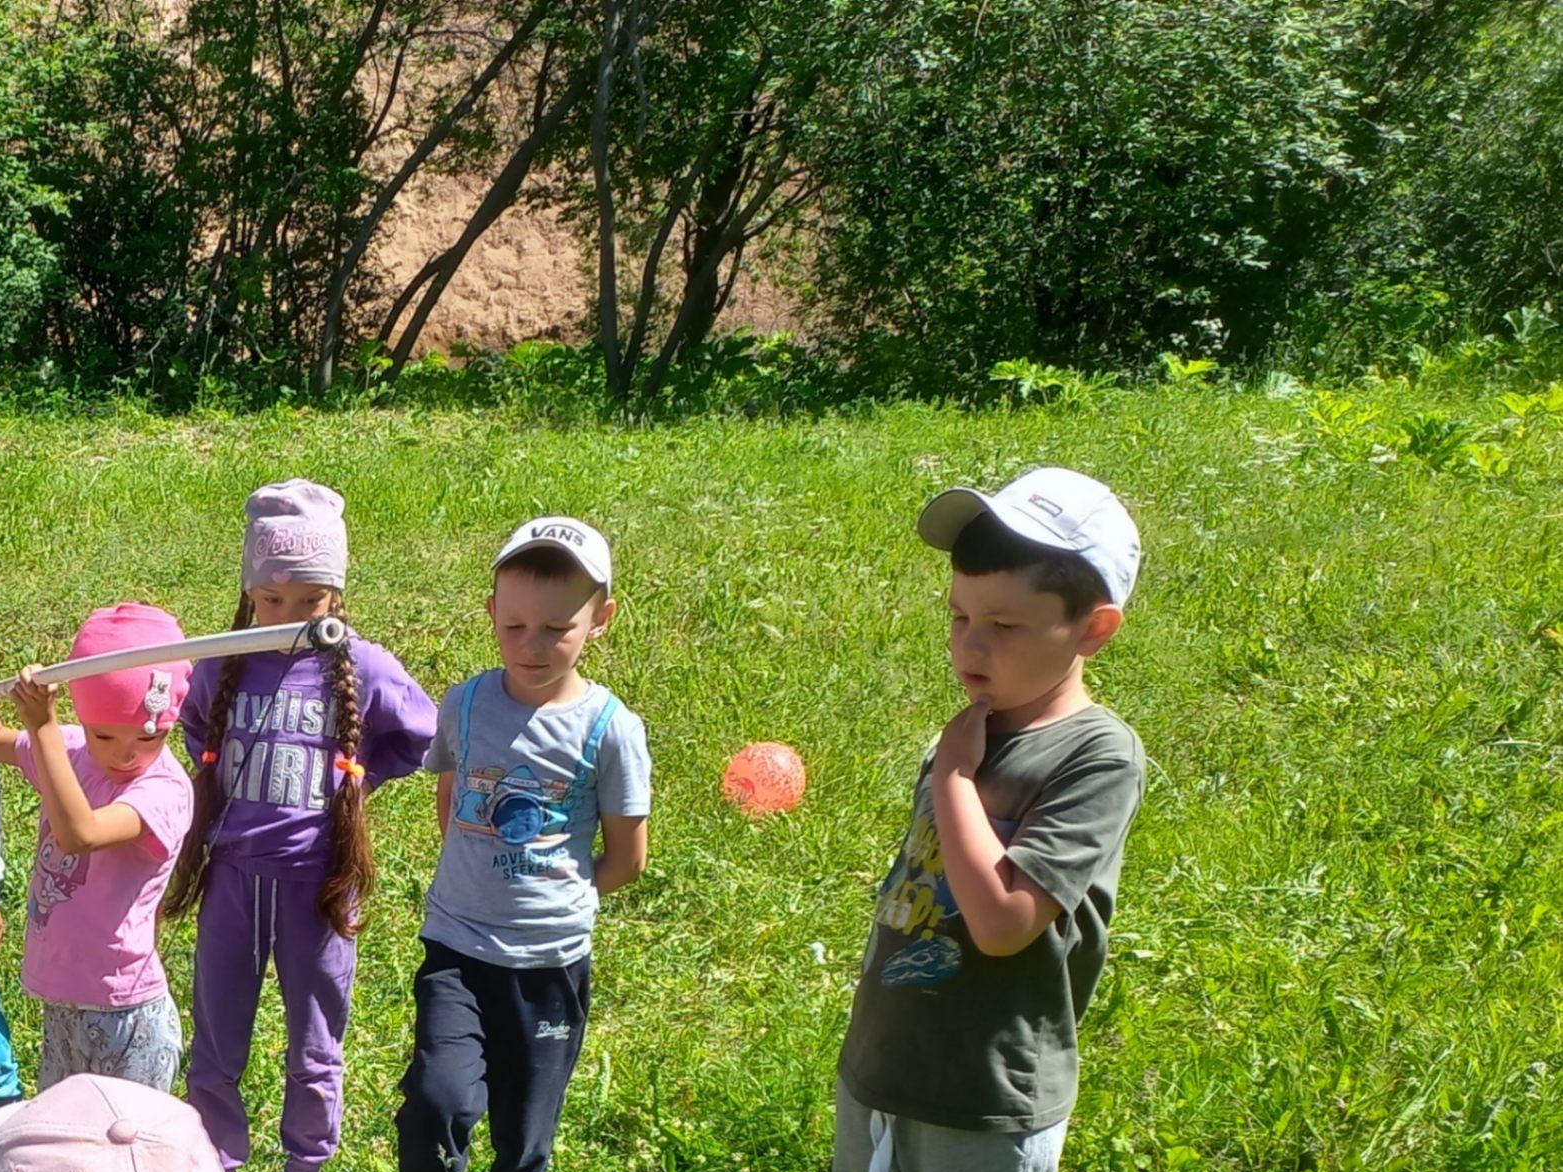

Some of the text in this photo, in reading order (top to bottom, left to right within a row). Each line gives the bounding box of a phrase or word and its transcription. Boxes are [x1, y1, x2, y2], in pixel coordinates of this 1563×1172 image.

[531, 523, 587, 547] VANS
[222, 738, 330, 810] GIRL
[503, 860, 554, 880] SEEKER
